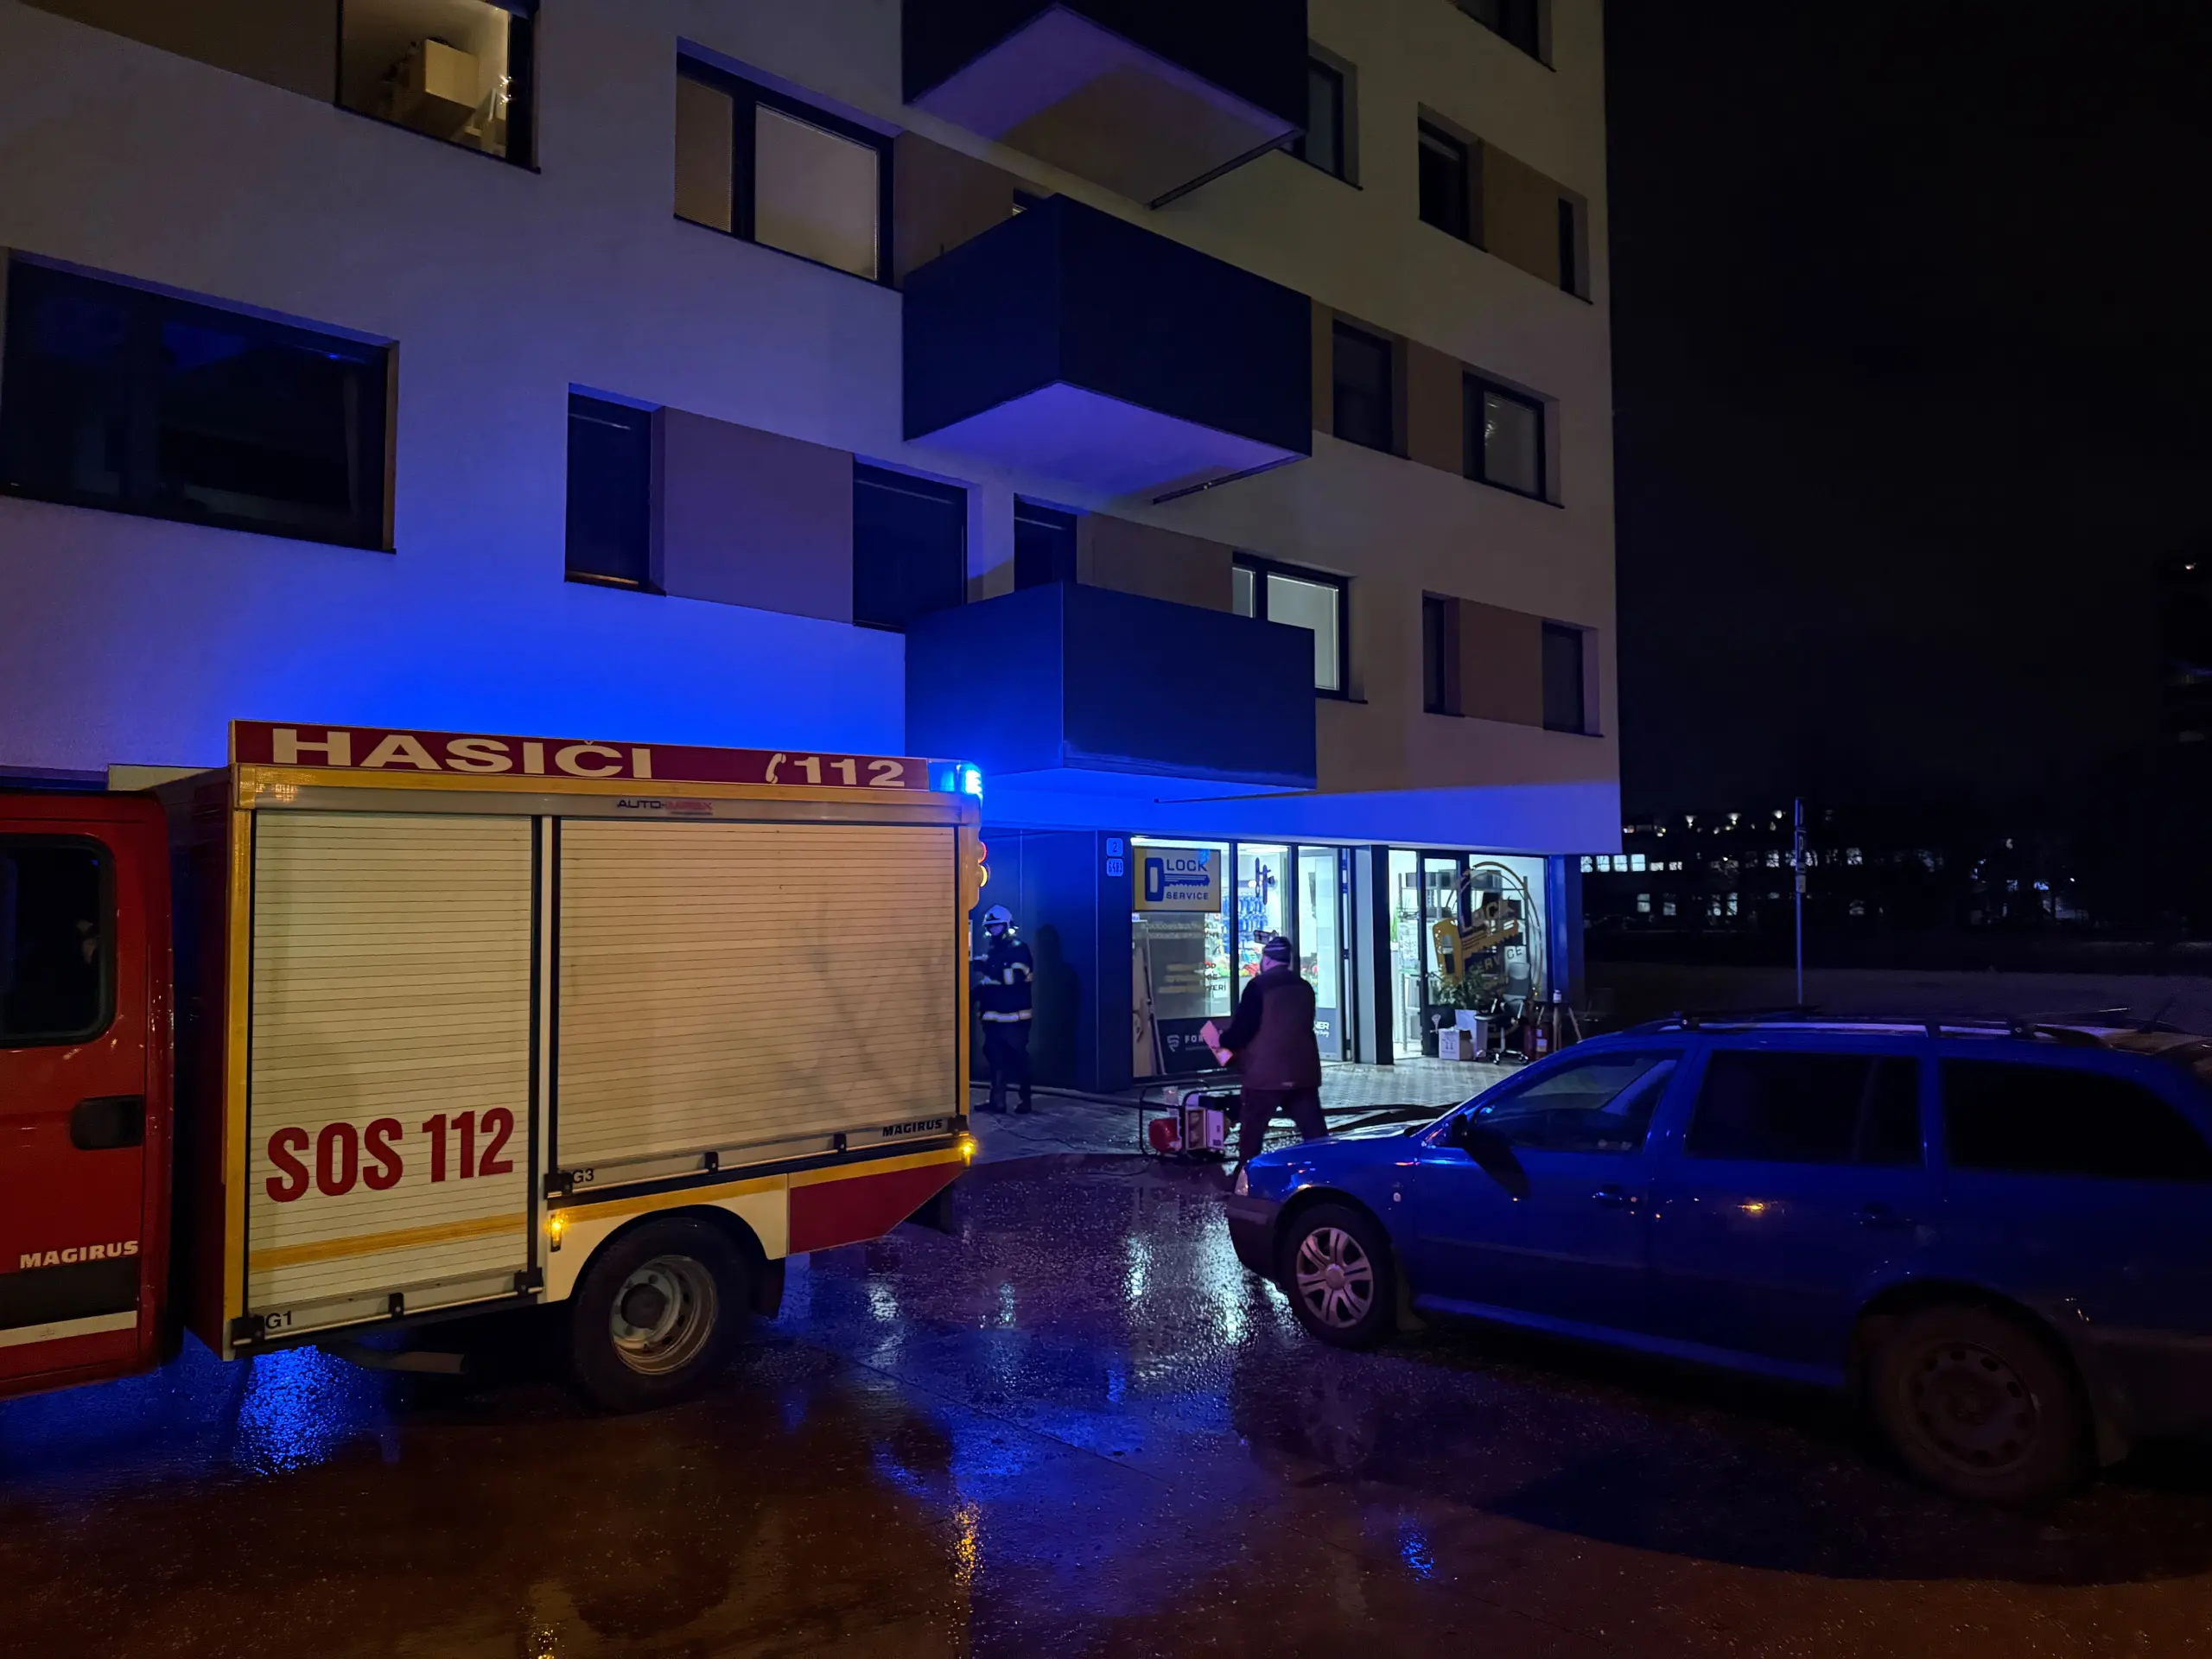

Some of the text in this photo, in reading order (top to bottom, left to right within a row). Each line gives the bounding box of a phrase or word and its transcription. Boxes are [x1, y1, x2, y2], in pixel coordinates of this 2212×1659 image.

[273, 728, 905, 787] HASIČI 112
[1166, 858, 1207, 872] LOCK
[1166, 892, 1209, 900] SERVICE
[1468, 946, 1522, 975] SERVCE
[882, 1118, 943, 1137] MAGIRUS
[266, 1107, 514, 1203] SOS 112
[572, 1168, 594, 1184] G3
[20, 1240, 139, 1269] MAGIRUS
[265, 1310, 292, 1329] G1
